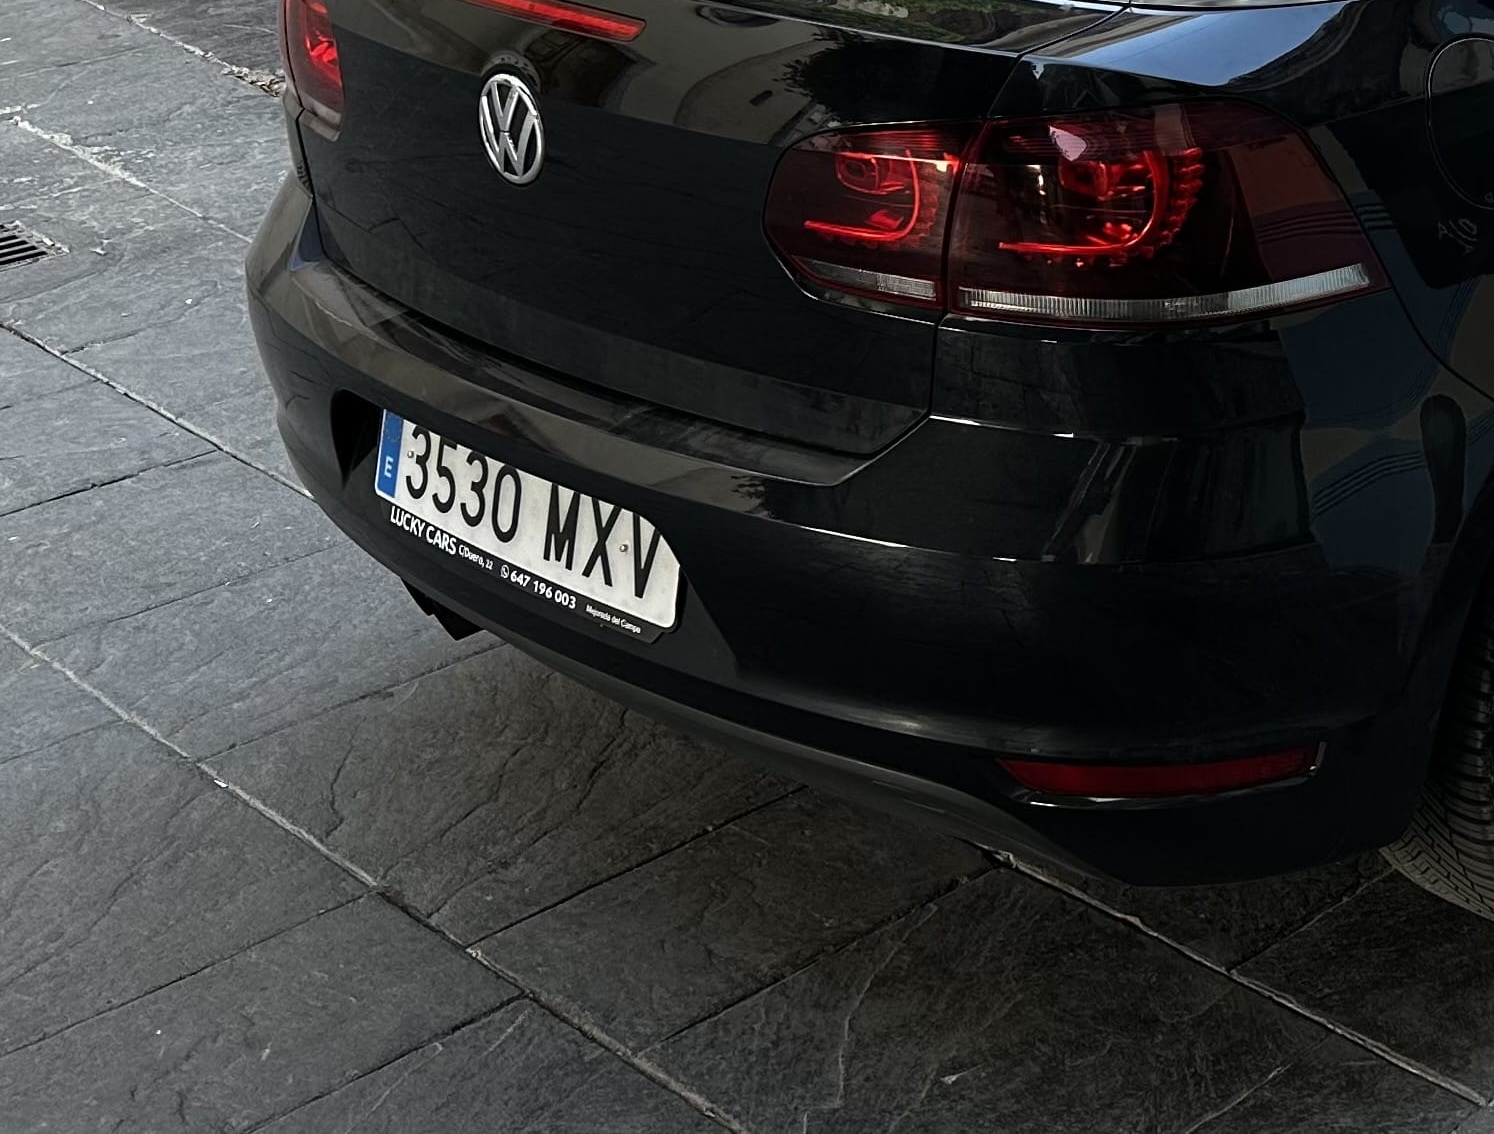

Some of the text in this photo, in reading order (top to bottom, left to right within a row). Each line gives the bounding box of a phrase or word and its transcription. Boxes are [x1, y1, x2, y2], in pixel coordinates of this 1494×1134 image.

[384, 455, 394, 478] E
[390, 506, 426, 538] LUCKY
[426, 526, 457, 555] CARS
[405, 425, 661, 600] 3530 MXV
[510, 570, 577, 610] 647 196 003
[611, 615, 621, 626] del
